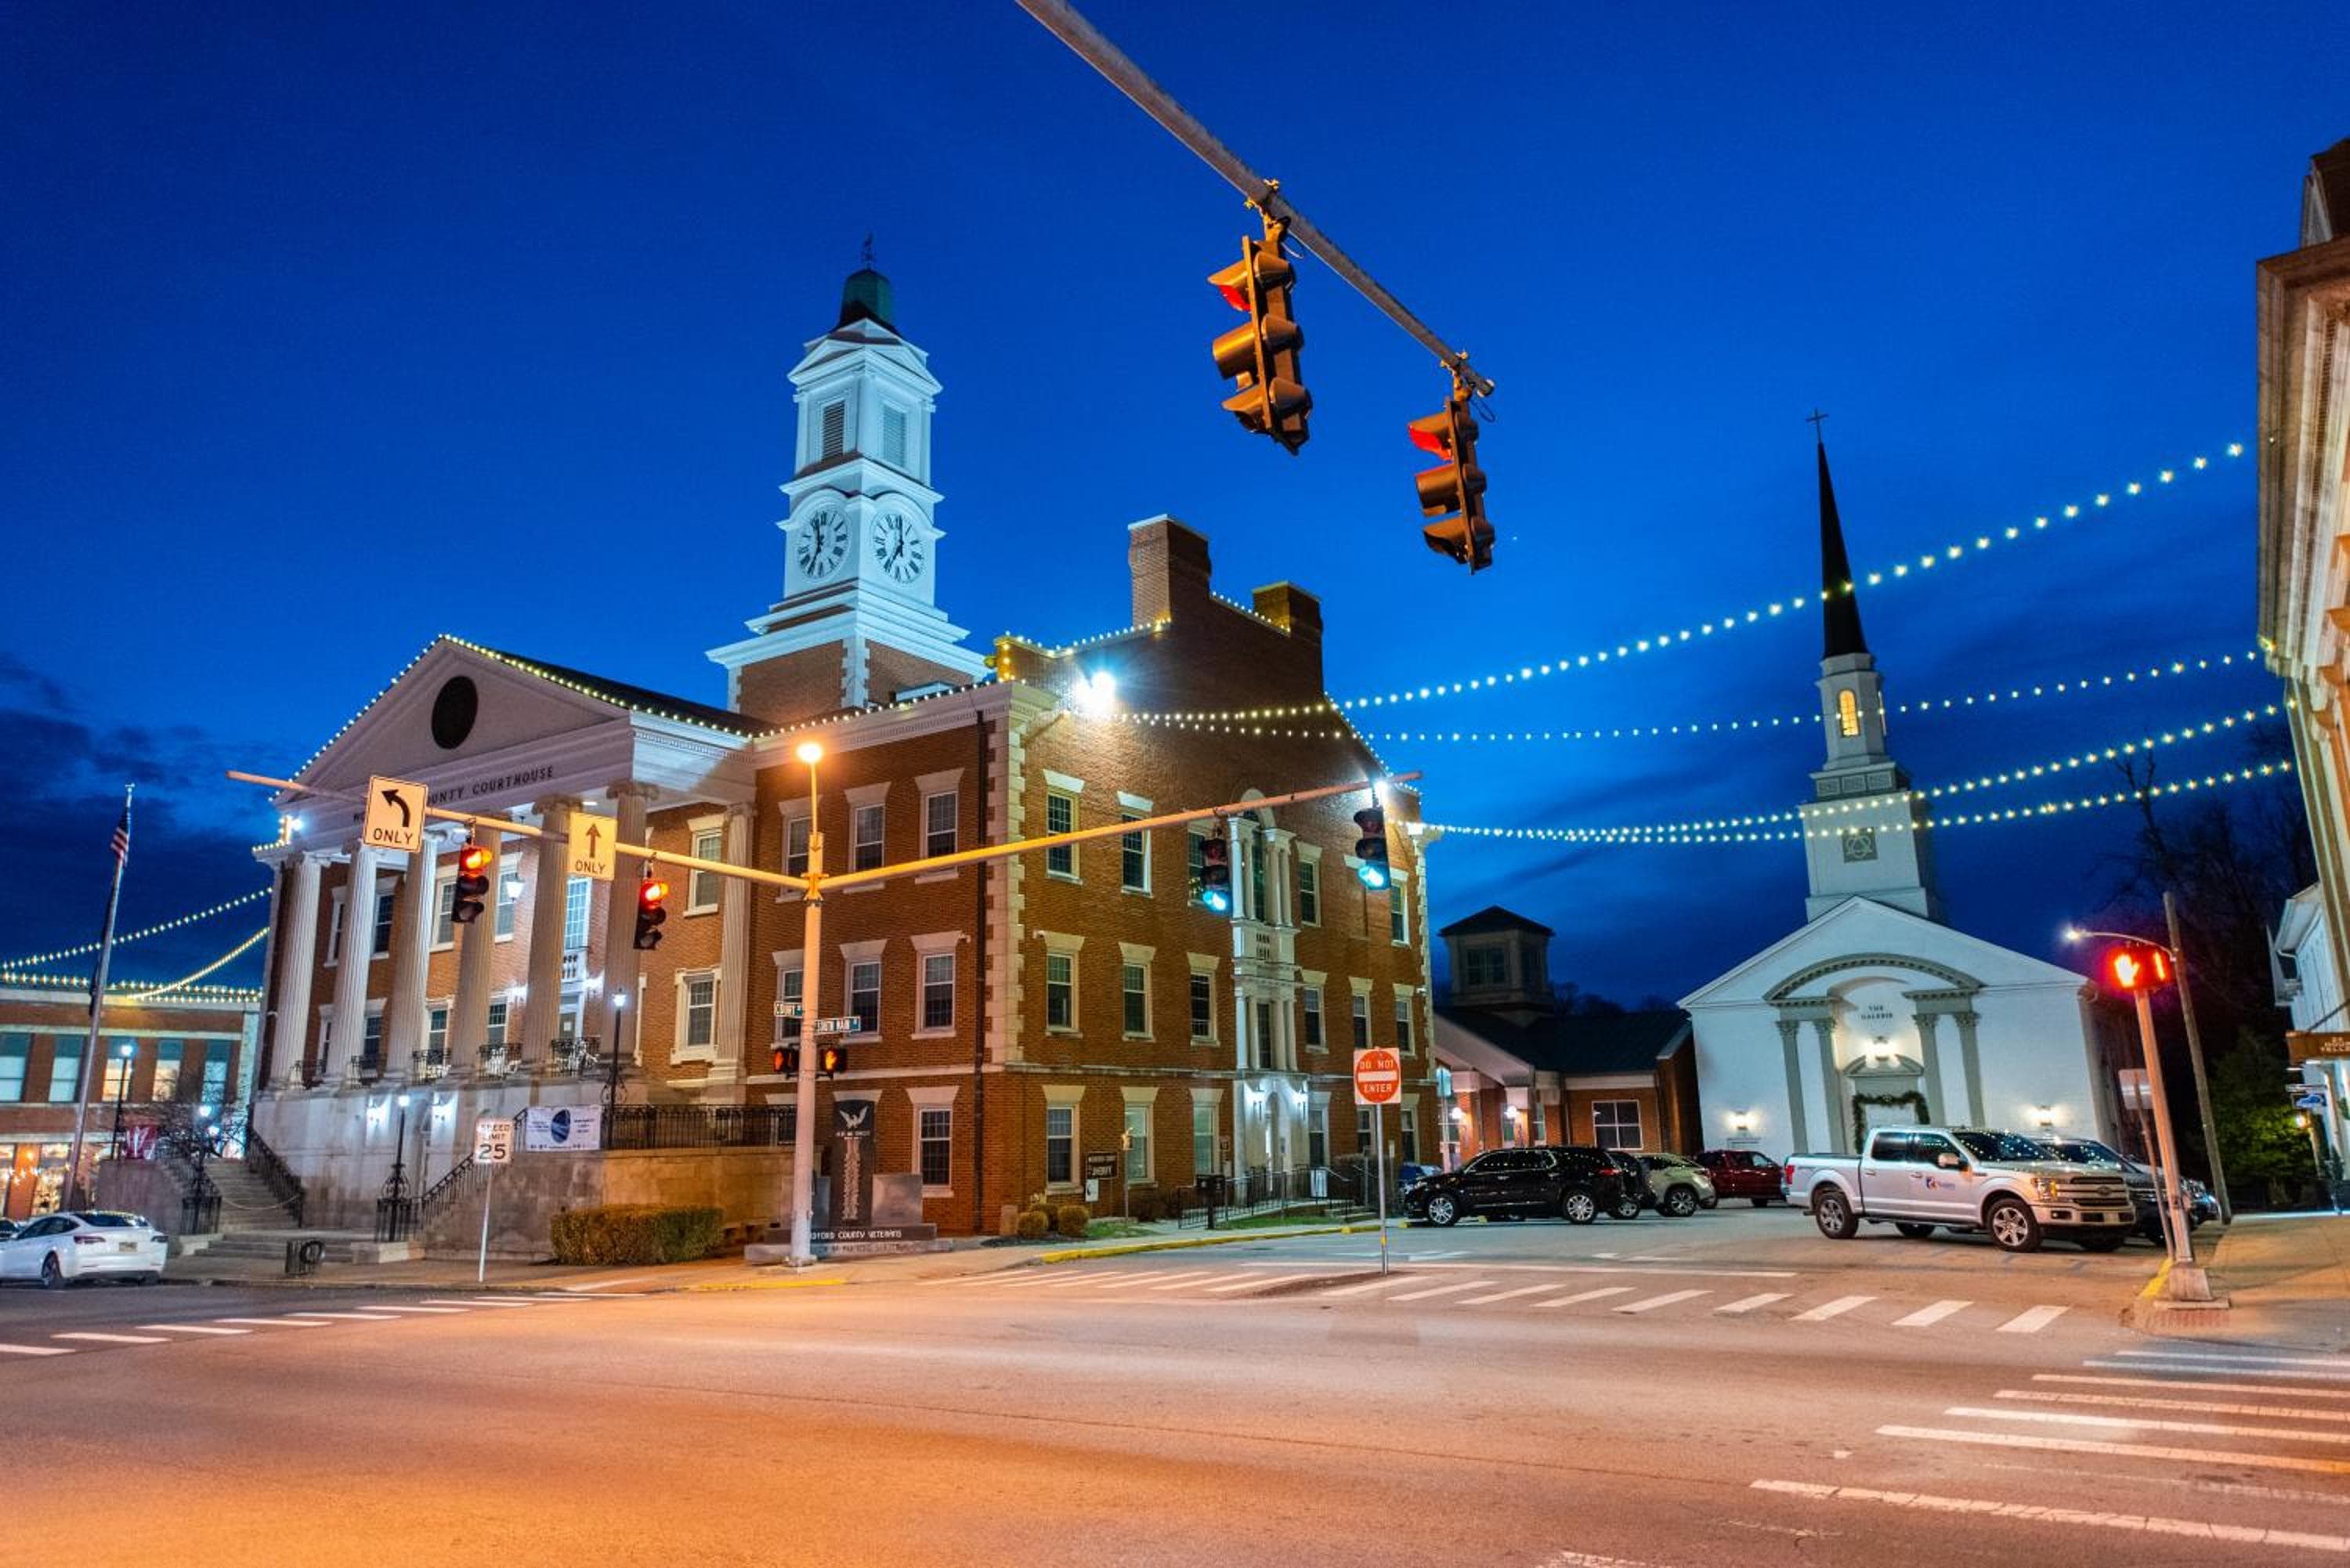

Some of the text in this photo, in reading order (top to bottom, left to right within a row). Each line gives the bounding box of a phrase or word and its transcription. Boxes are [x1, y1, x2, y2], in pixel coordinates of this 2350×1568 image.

[428, 765, 553, 804] UNTY COURTHOUSE
[374, 828, 414, 845] ONLY
[575, 859, 606, 873] ONLY
[1360, 1059, 1394, 1070] DO NOT
[1364, 1083, 1392, 1094] ENTER
[479, 1143, 506, 1159] 25
[837, 1230, 866, 1239] COUNTY
